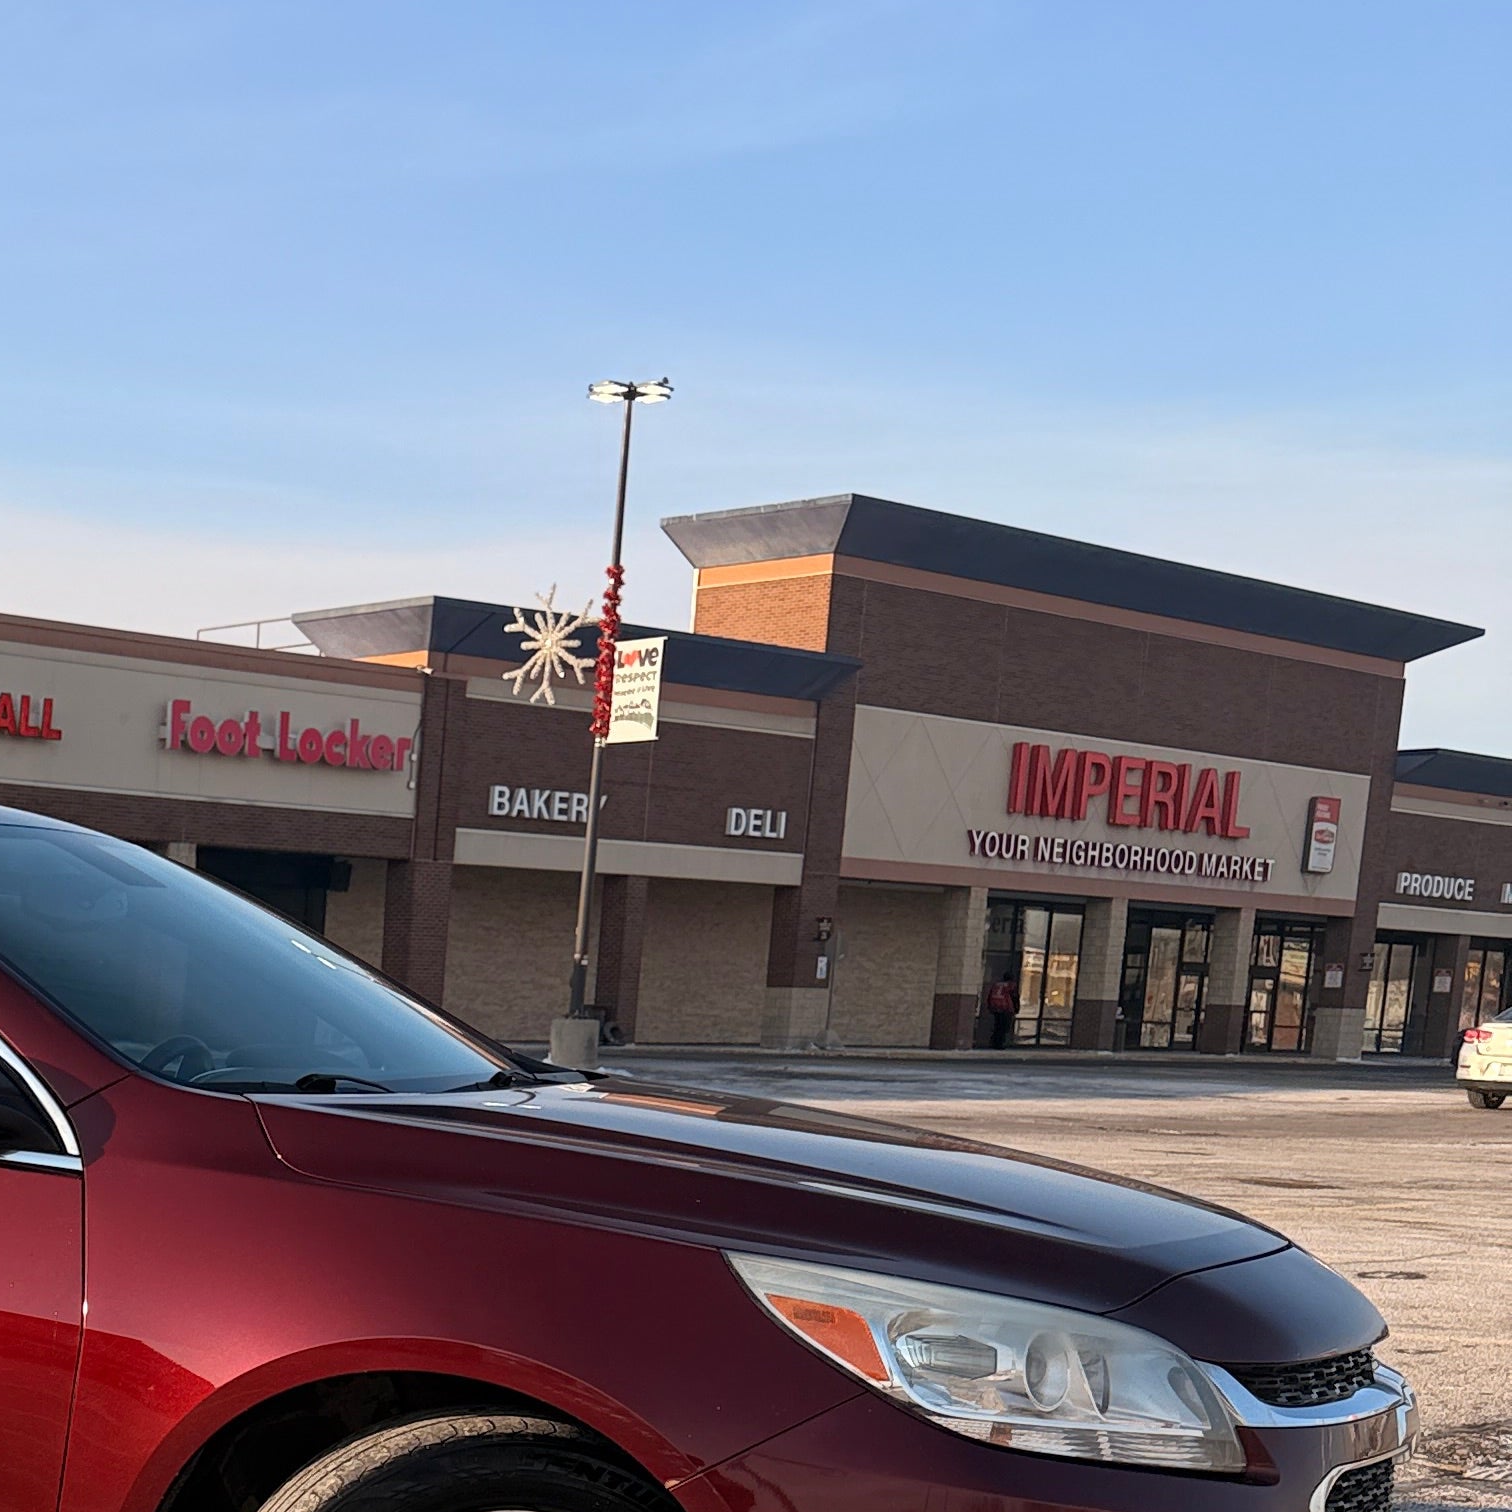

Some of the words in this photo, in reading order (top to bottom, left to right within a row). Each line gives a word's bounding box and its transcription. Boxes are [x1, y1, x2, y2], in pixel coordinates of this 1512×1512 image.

[167, 699, 261, 758] Foot
[275, 711, 412, 772] Locker
[488, 784, 608, 824] BAKER
[1007, 742, 1250, 838] IMPERIAL
[725, 807, 787, 840] DELI
[969, 829, 1030, 860] YOUR
[1035, 836, 1197, 876] NEIGHBORHOOD
[1199, 853, 1275, 882] MARKET
[1395, 872, 1475, 901] PRODUCE
